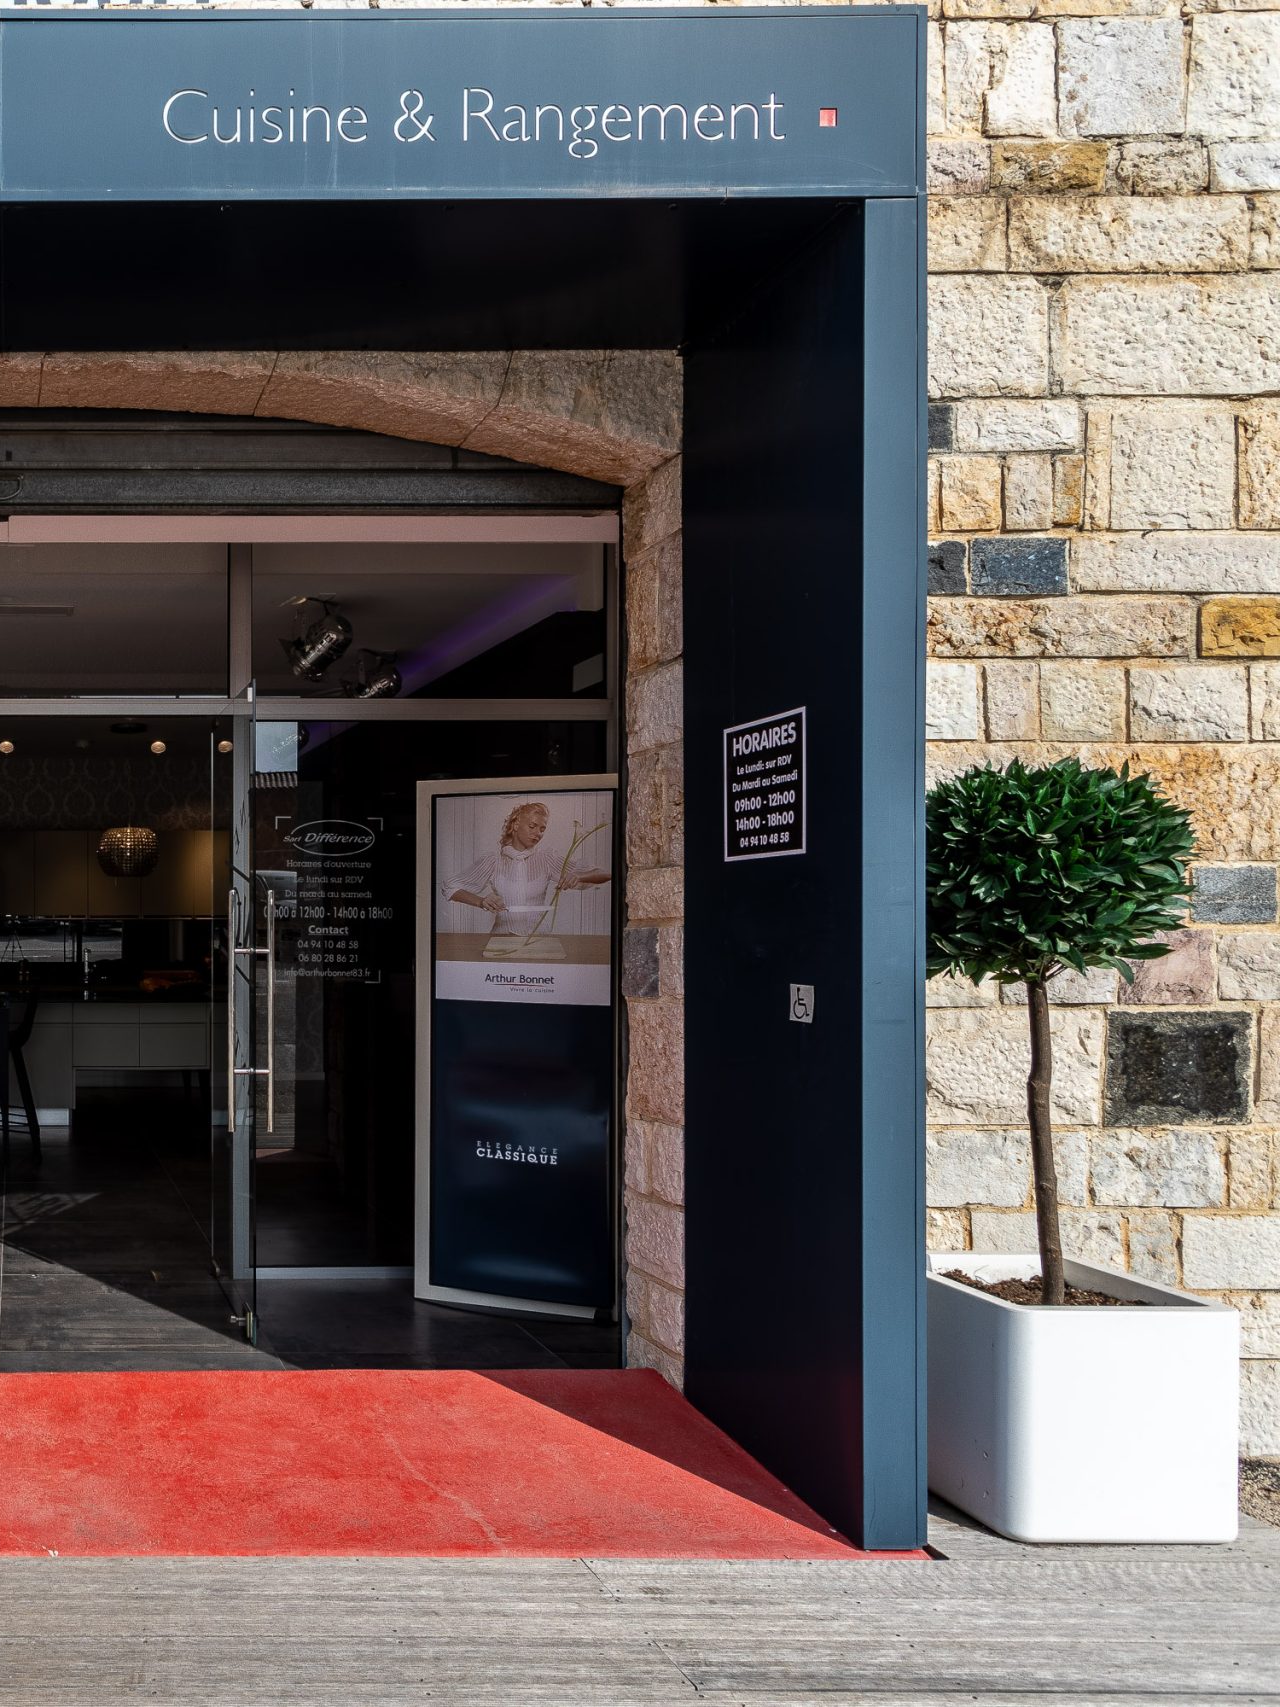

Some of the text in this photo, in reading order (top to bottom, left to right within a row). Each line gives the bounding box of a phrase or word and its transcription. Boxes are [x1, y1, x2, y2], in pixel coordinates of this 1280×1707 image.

[162, 87, 785, 158] Cuisine & Rangement
[732, 722, 797, 757] HORAIRES
[736, 765, 745, 775] Le
[765, 759, 776, 770] sur
[777, 754, 792, 766] RDV
[732, 769, 798, 792] Du Mardi au Samedi
[734, 796, 762, 813] 09h00
[768, 790, 796, 807] 12h00
[736, 816, 761, 832] 14h00
[767, 810, 795, 827] 18h00
[304, 832, 373, 845] Différence
[740, 832, 790, 848] 04 94 10 48 58
[286, 860, 372, 869] Horaires d'ouverture
[306, 875, 329, 885] lundi
[330, 877, 343, 885] sur
[344, 876, 364, 885] RDV
[285, 890, 297, 899] Du
[340, 890, 372, 899] samedi
[299, 906, 325, 919] 12h00
[333, 906, 359, 920] 14h00
[369, 906, 393, 920] 18h00
[308, 924, 349, 934] Contact
[298, 940, 359, 949] 04 94 10 48 58
[298, 954, 359, 963] 06 80 28 86 21
[484, 974, 555, 985] Arthur Bonnet
[476, 1148, 558, 1165] CLASSIQUE
